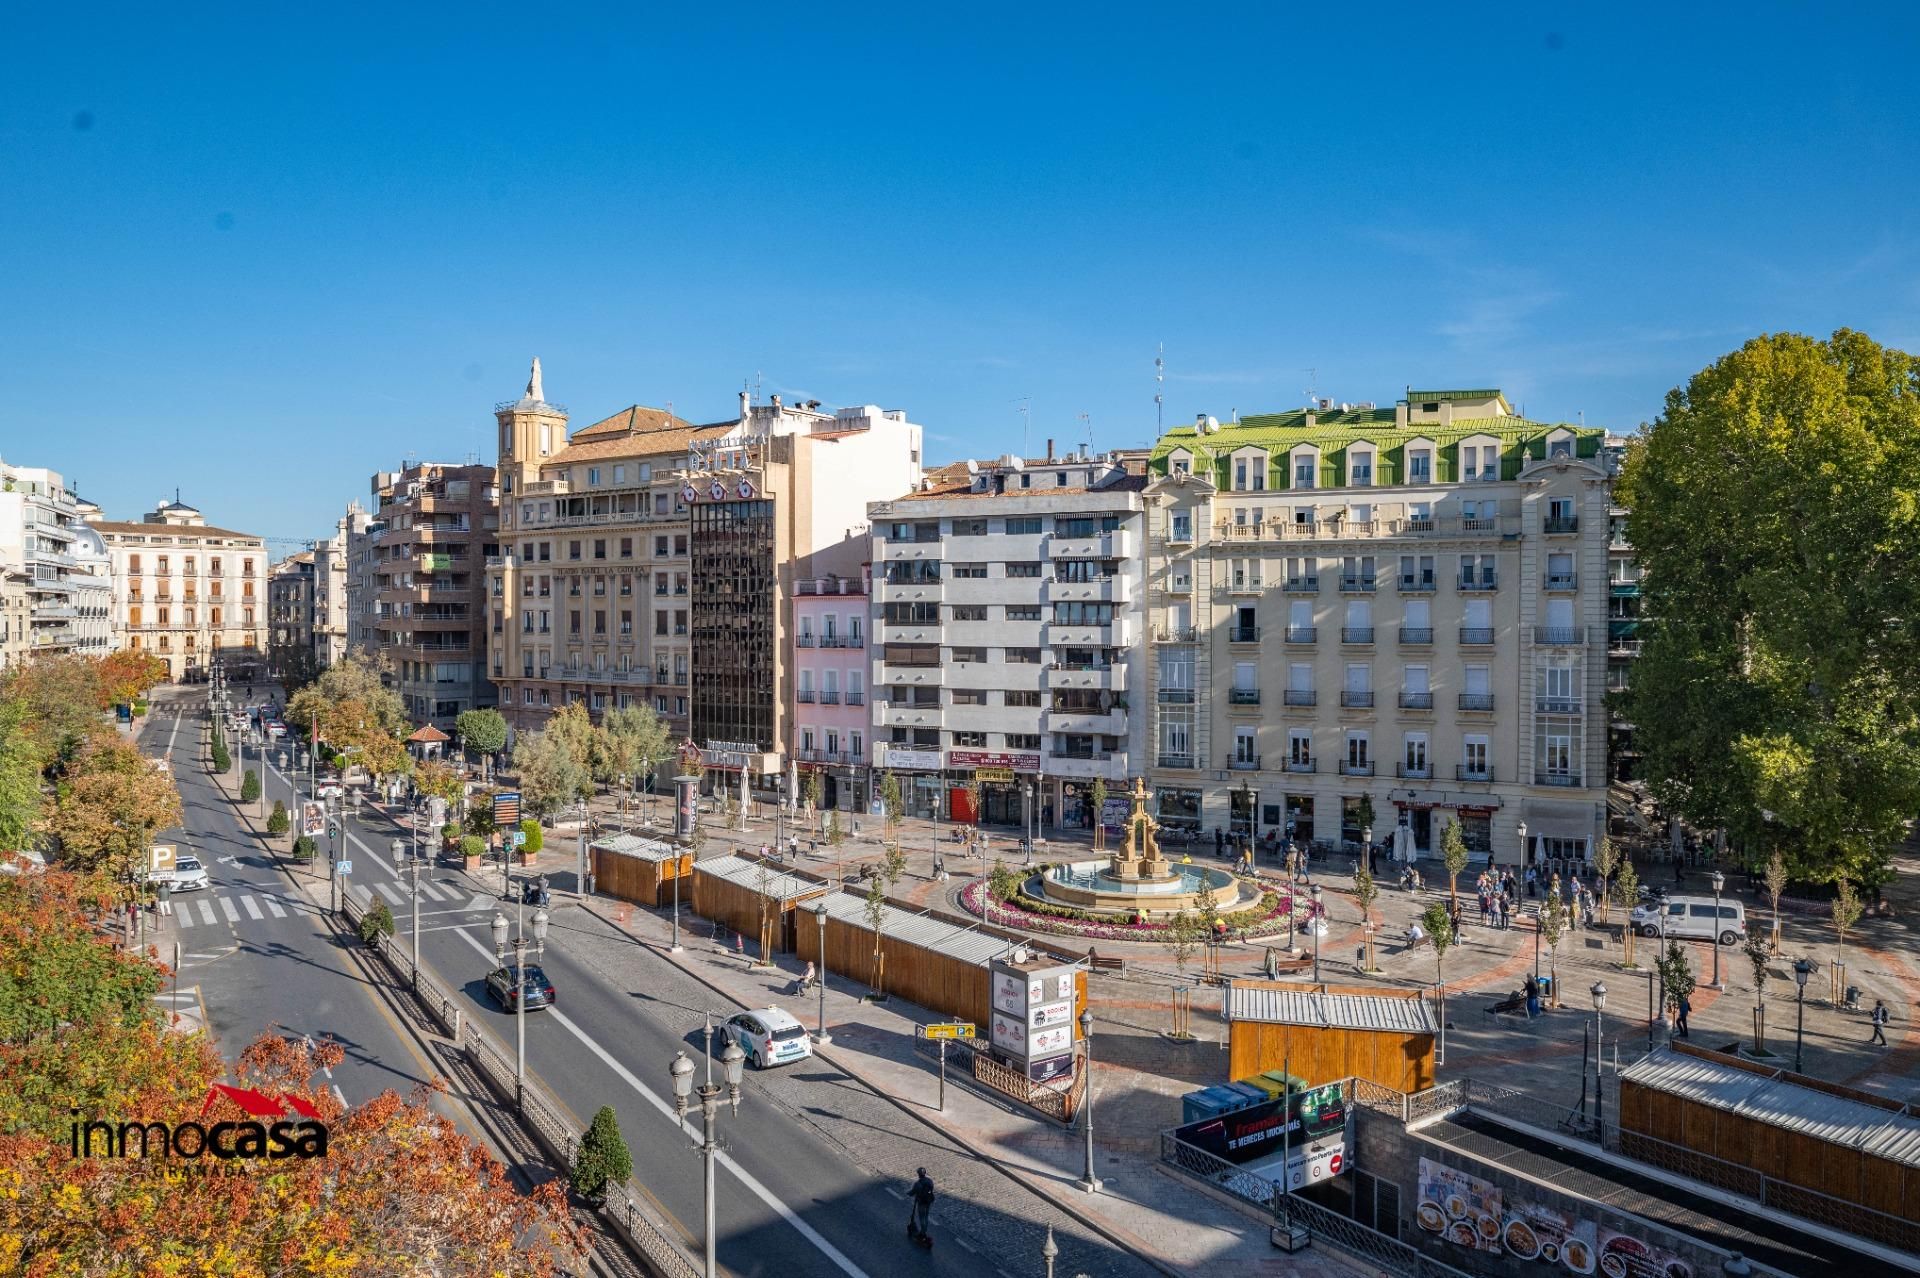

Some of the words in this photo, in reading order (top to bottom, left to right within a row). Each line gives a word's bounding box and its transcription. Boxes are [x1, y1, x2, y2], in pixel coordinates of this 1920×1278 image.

[152, 847, 172, 869] P
[1228, 1139, 1237, 1150] TE
[1238, 1132, 1265, 1147] MERECES
[1266, 1124, 1287, 1138] MUCH
